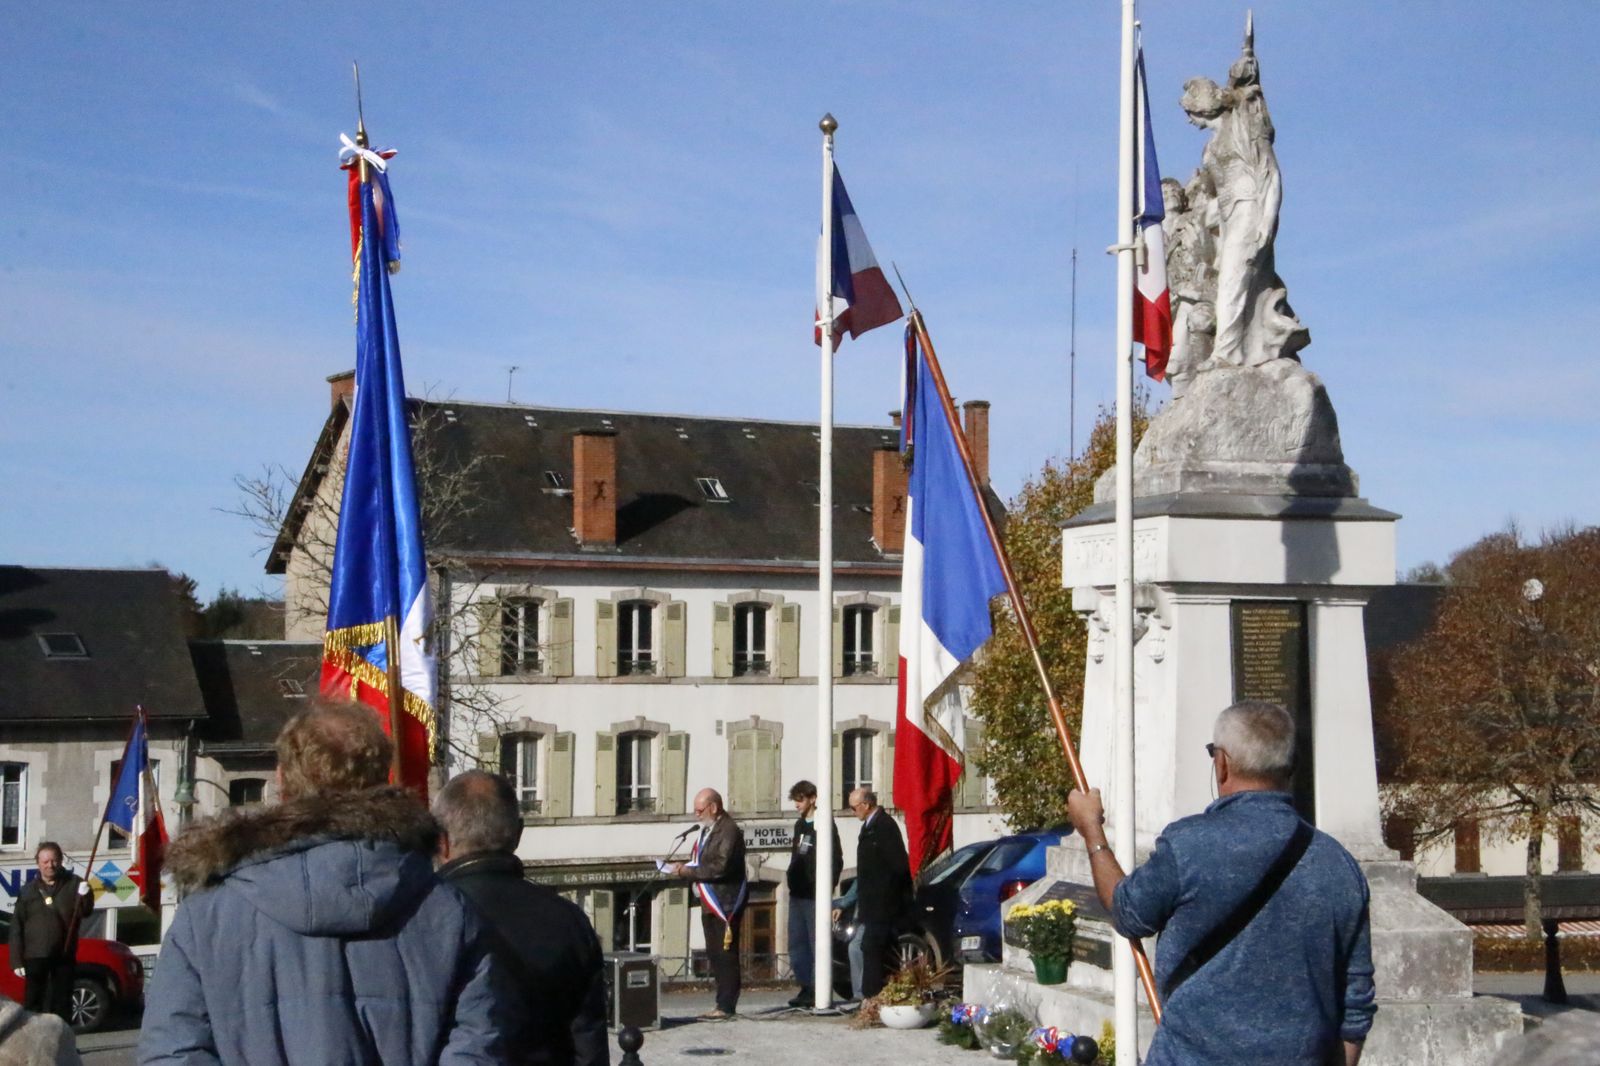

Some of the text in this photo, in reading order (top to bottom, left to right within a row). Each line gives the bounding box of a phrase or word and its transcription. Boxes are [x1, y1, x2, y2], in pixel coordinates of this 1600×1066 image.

[754, 828, 788, 838] HOTEL
[759, 837, 794, 846] BLANCH
[563, 874, 578, 883] LA
[581, 873, 613, 882] CROIX
